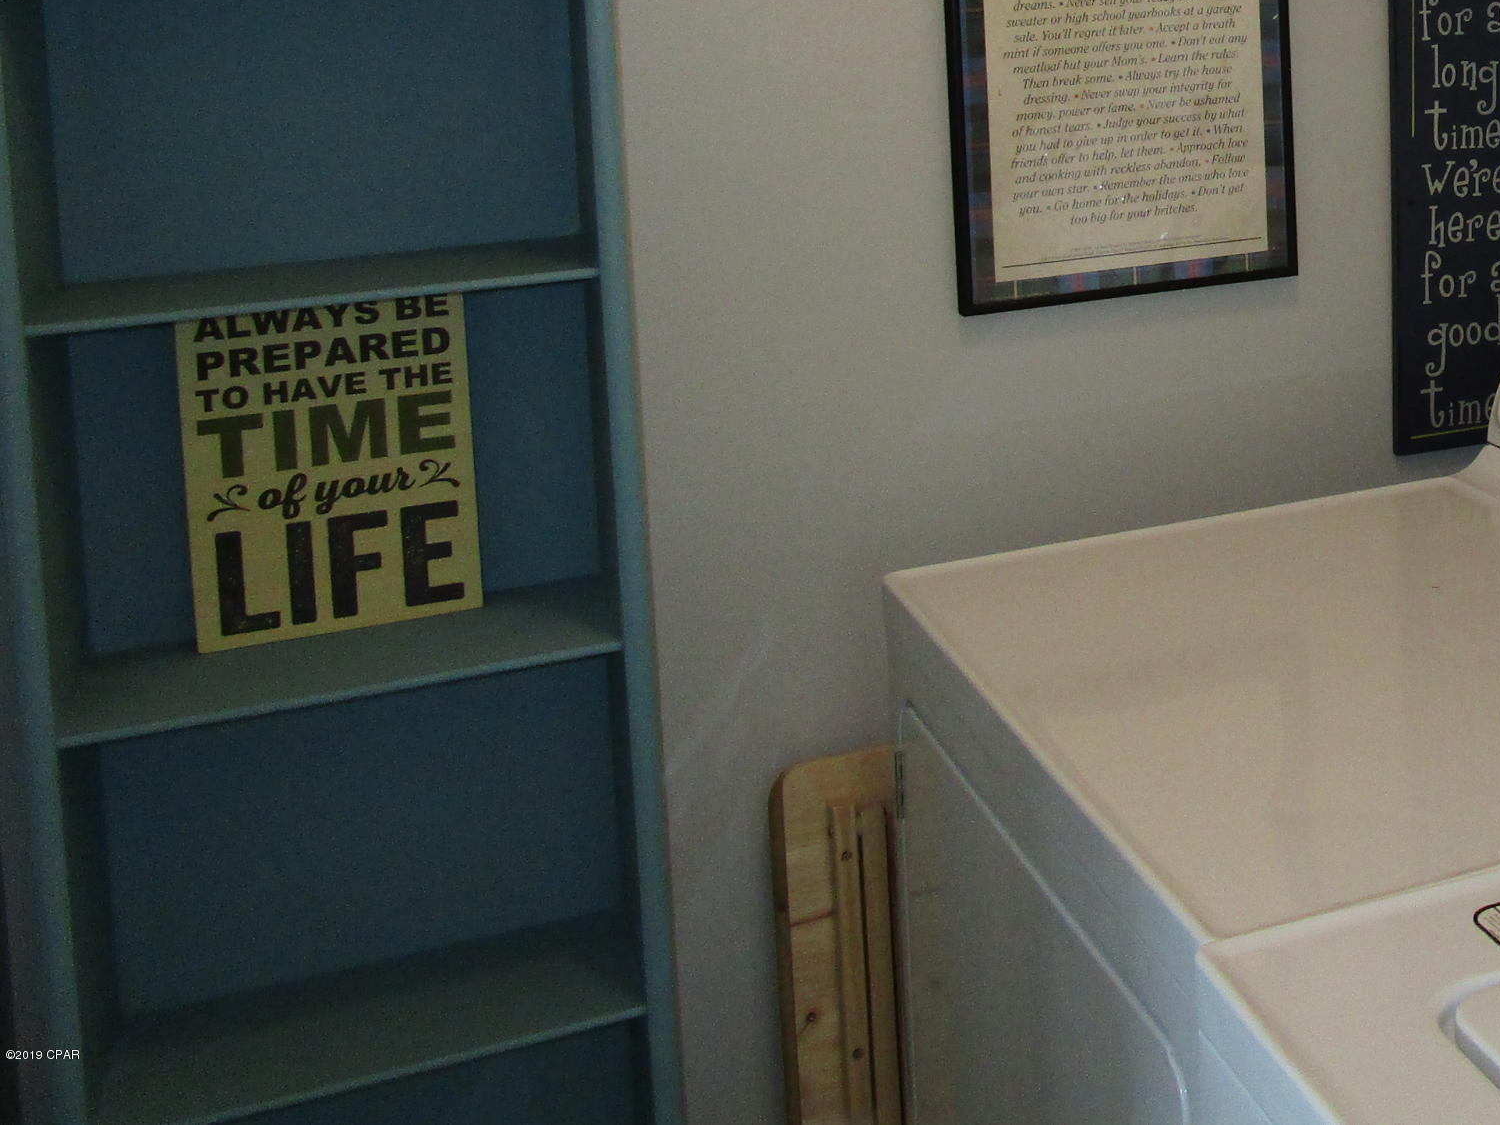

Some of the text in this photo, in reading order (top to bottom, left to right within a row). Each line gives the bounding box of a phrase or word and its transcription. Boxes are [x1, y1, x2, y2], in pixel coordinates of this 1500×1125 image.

[1051, 15, 1062, 24] or
[1065, 12, 1088, 25] high
[1092, 10, 1125, 21] school
[1128, 7, 1181, 21] yearbooks
[1184, 6, 1195, 15] at
[1197, 7, 1203, 15] a
[1206, 4, 1242, 17] garage
[1431, 44, 1499, 115] long
[1071, 214, 1088, 225] too
[1090, 212, 1106, 224] big
[1110, 210, 1125, 222] for
[1127, 209, 1152, 222] your
[1420, 250, 1476, 305] for
[193, 293, 449, 342] ALWAYS BE
[196, 326, 451, 381] PREPARED
[195, 362, 453, 413] TO HAVE THE
[197, 390, 455, 478] TIME
[257, 466, 416, 520] of your
[214, 500, 465, 637] LIFE
